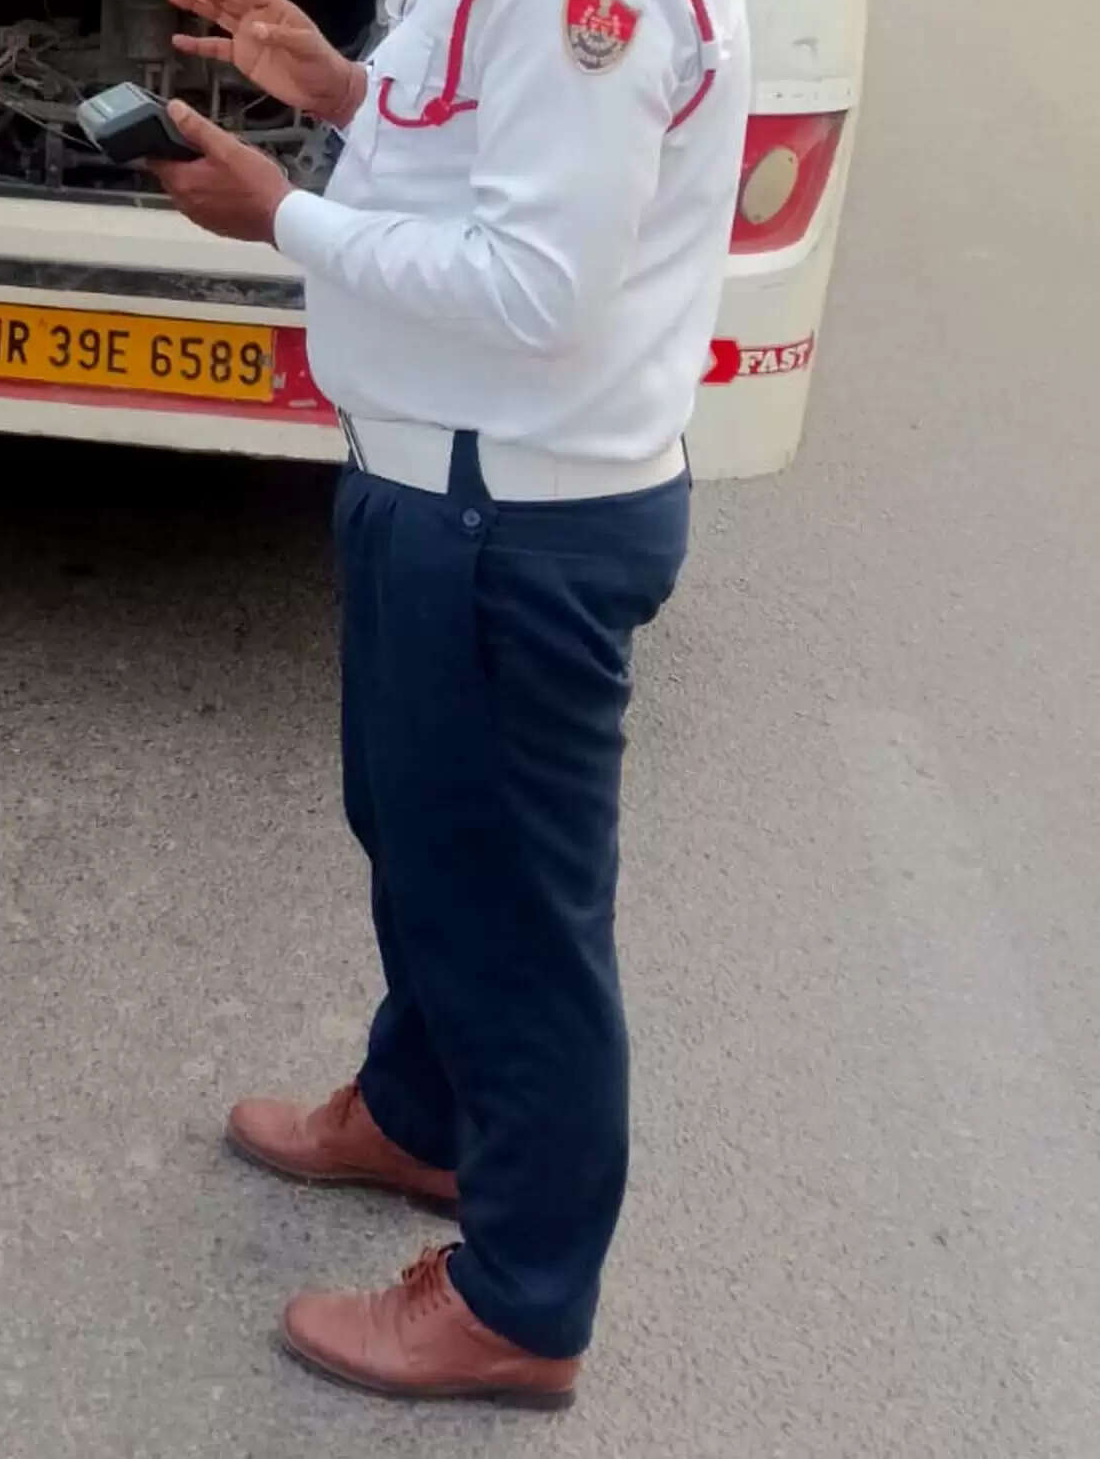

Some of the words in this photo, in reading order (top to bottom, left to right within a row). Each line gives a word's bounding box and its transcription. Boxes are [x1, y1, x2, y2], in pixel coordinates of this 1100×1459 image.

[49, 325, 131, 374] 39E
[150, 335, 262, 386] 6589
[738, 342, 810, 375] FAST
